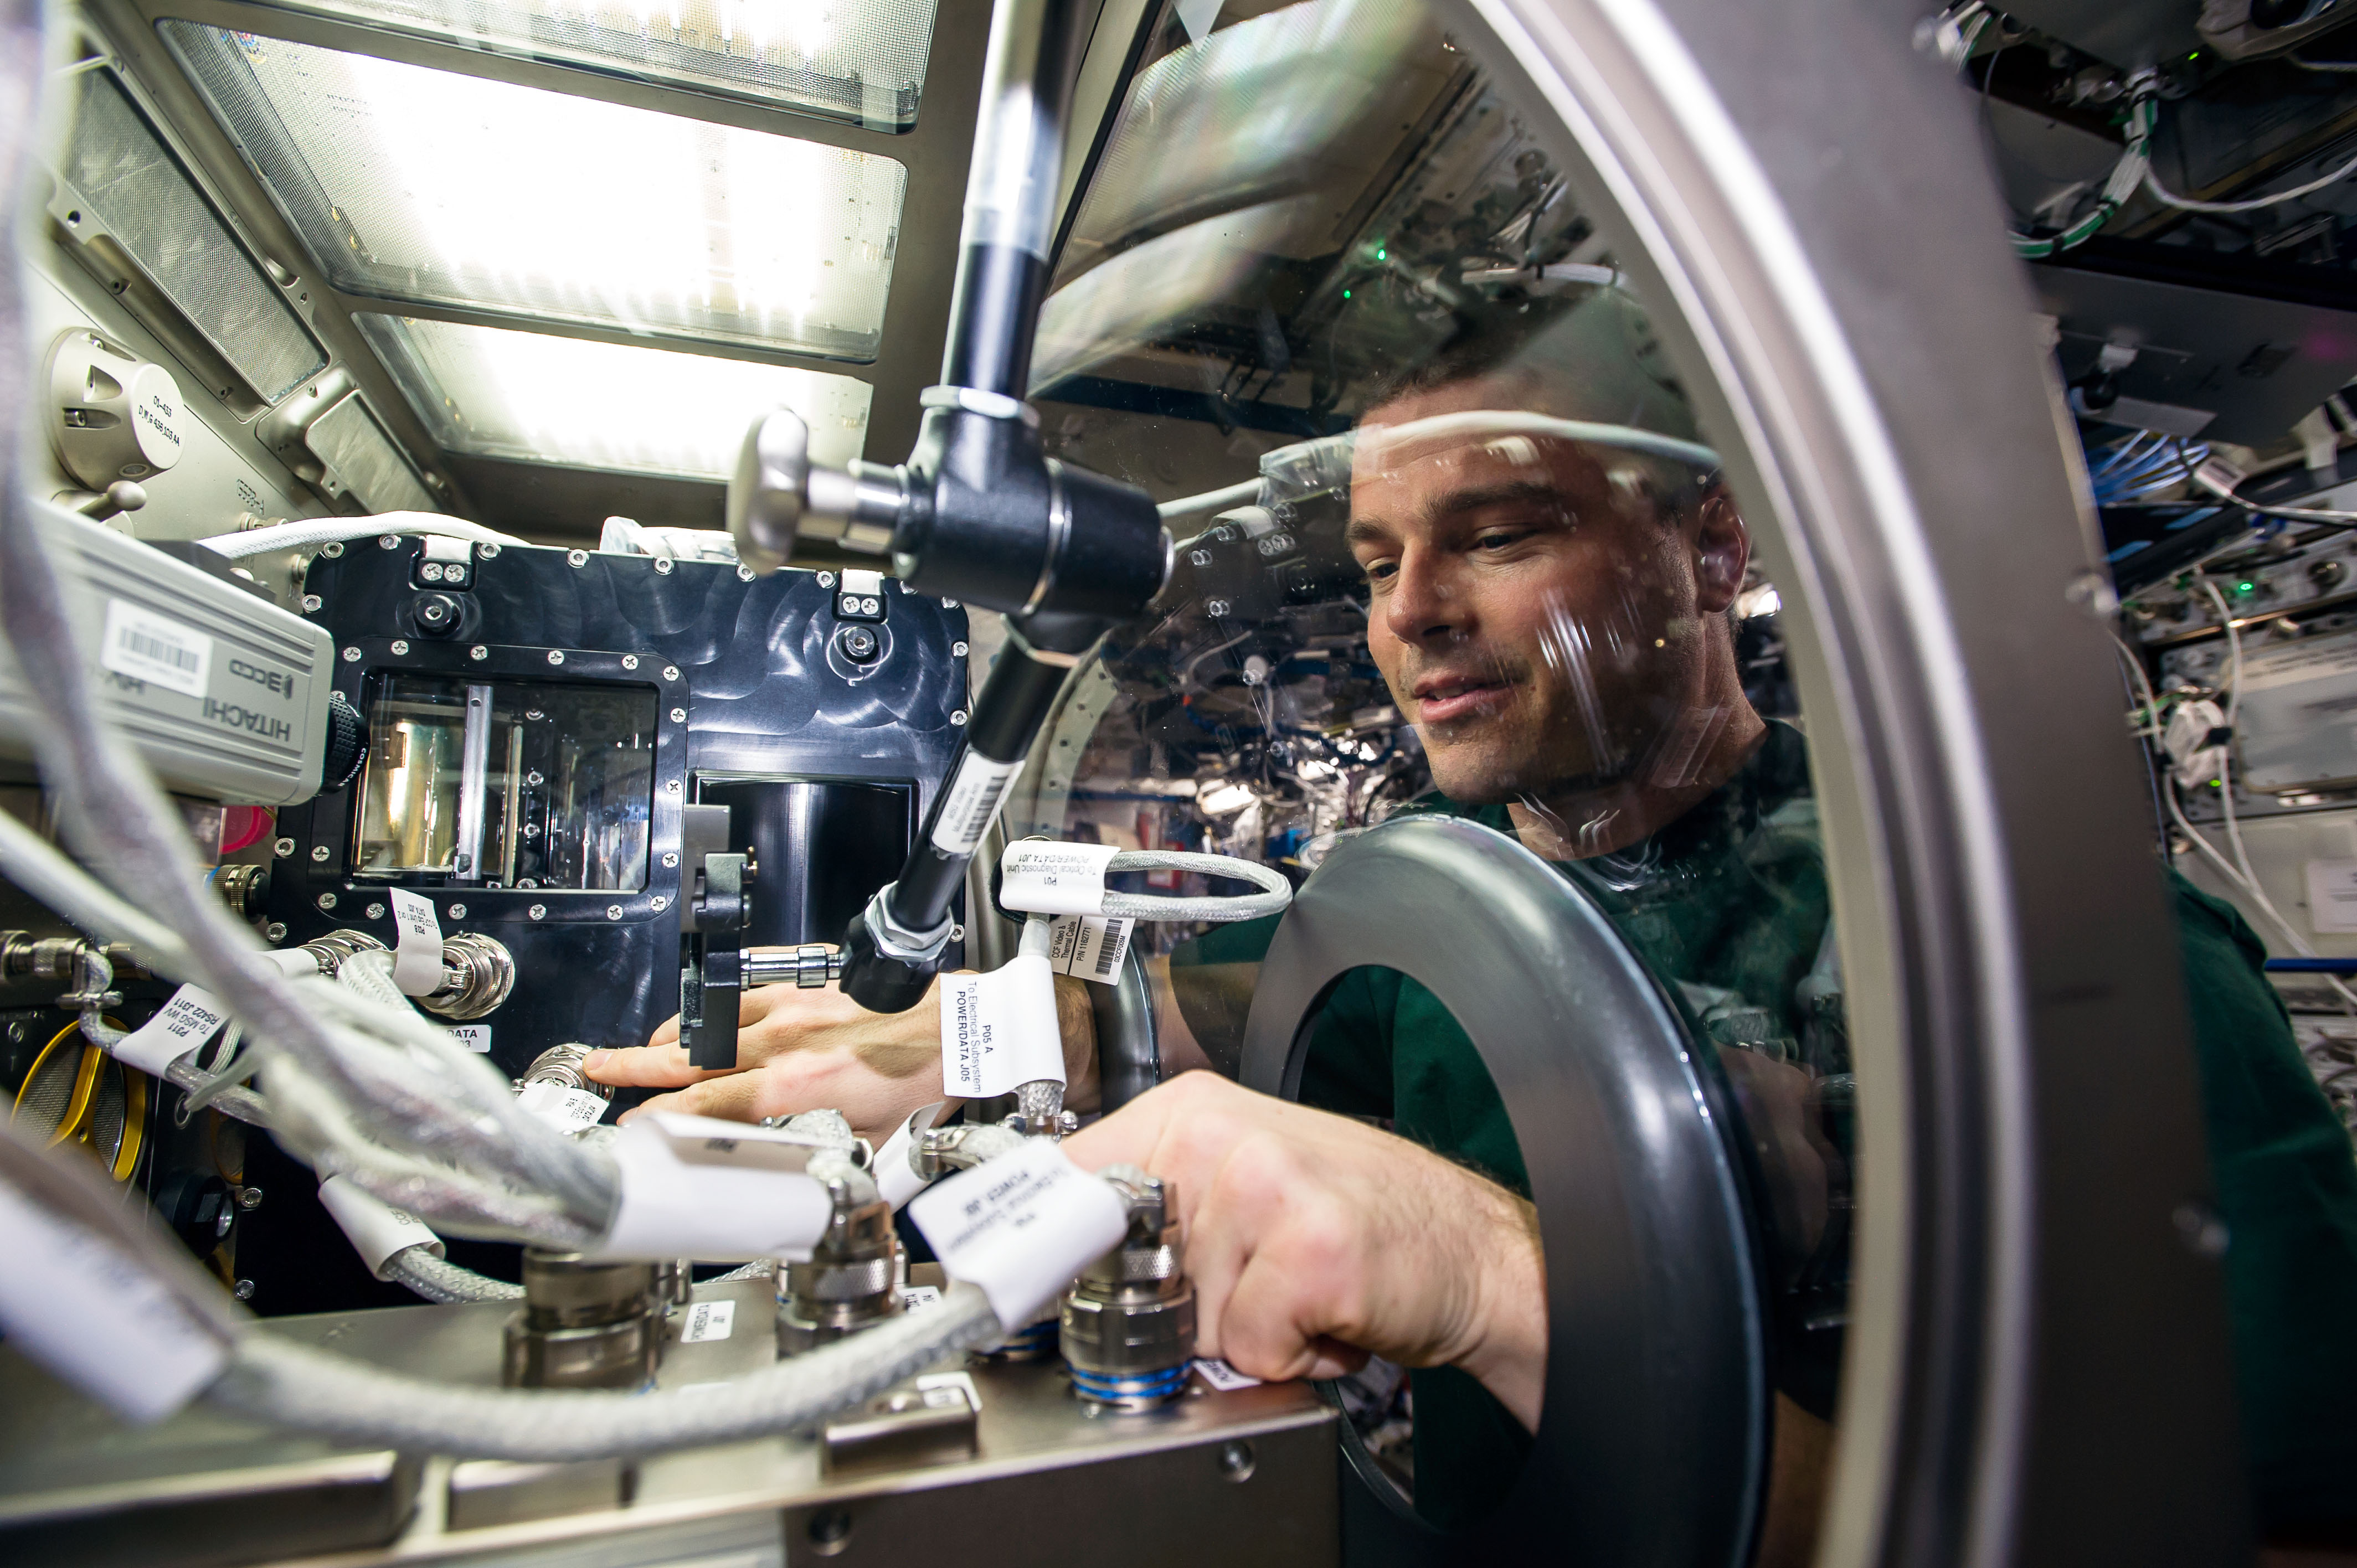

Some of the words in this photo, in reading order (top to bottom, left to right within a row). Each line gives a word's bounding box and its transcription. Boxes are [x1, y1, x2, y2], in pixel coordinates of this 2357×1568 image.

[203, 697, 291, 742] HITACHI
[337, 747, 367, 787] COSMICAR
[1018, 854, 1032, 862] J01
[1007, 864, 1019, 873] Unit
[1021, 863, 1057, 875] Diagnostic
[1059, 865, 1084, 875] Optical
[1087, 867, 1097, 875] To
[1044, 877, 1057, 886] P01
[1066, 921, 1077, 937] Cable
[1054, 931, 1064, 945] Video
[1080, 927, 1092, 950] 1162771
[1052, 946, 1061, 958] CCF
[1061, 937, 1072, 959] Thermal
[1077, 950, 1086, 962] P/N
[968, 981, 977, 993] To
[174, 998, 195, 1011] J311
[178, 1014, 199, 1029] MSG
[192, 1007, 220, 1025] RS422
[968, 996, 979, 1037] Electrical
[167, 1023, 190, 1037] P311
[199, 1024, 210, 1035] To
[956, 991, 969, 1061] POWER/DATA
[447, 1029, 478, 1038] DATA
[982, 1024, 992, 1043] P05
[960, 1064, 970, 1082] J05
[970, 1040, 981, 1093] Subsystem
